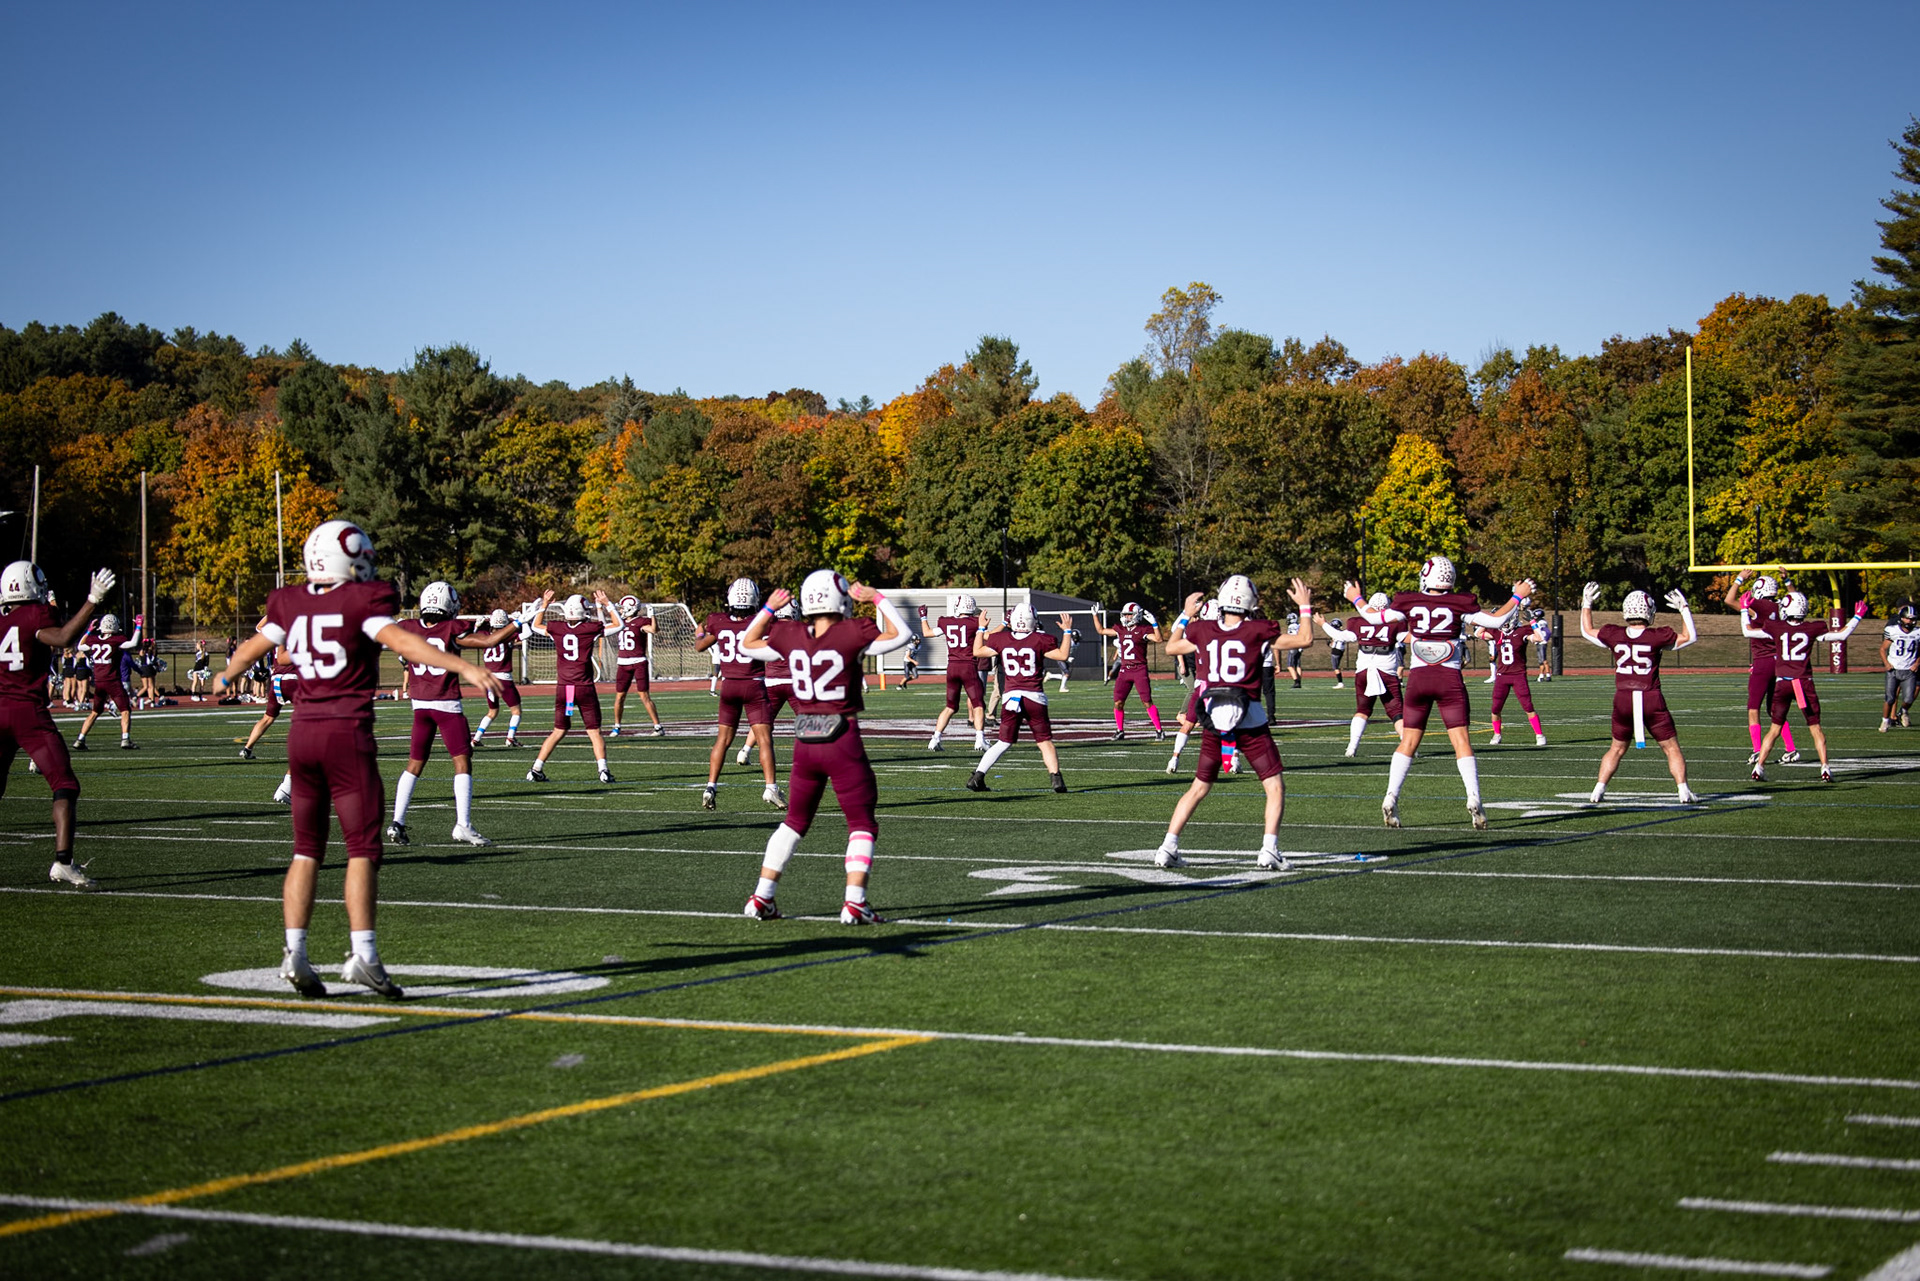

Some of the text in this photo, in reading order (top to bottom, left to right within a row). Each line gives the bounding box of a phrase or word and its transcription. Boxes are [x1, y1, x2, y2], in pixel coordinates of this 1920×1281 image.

[8, 582, 20, 593] 44
[1360, 625, 1389, 642] 74
[1409, 606, 1454, 634] 32
[286, 613, 348, 680] 45
[562, 633, 579, 661] 9
[945, 625, 968, 648] 51
[1122, 638, 1136, 660] 2
[1780, 632, 1809, 661] 12
[1831, 617, 1842, 666] RMS
[1896, 639, 1917, 658] 34
[91, 643, 113, 664] 22
[1001, 647, 1036, 677] 63
[1206, 639, 1247, 684] 16
[1500, 642, 1514, 665] 8
[1614, 643, 1653, 675] 25
[788, 649, 846, 702] 82
[797, 717, 836, 732] DAWG
